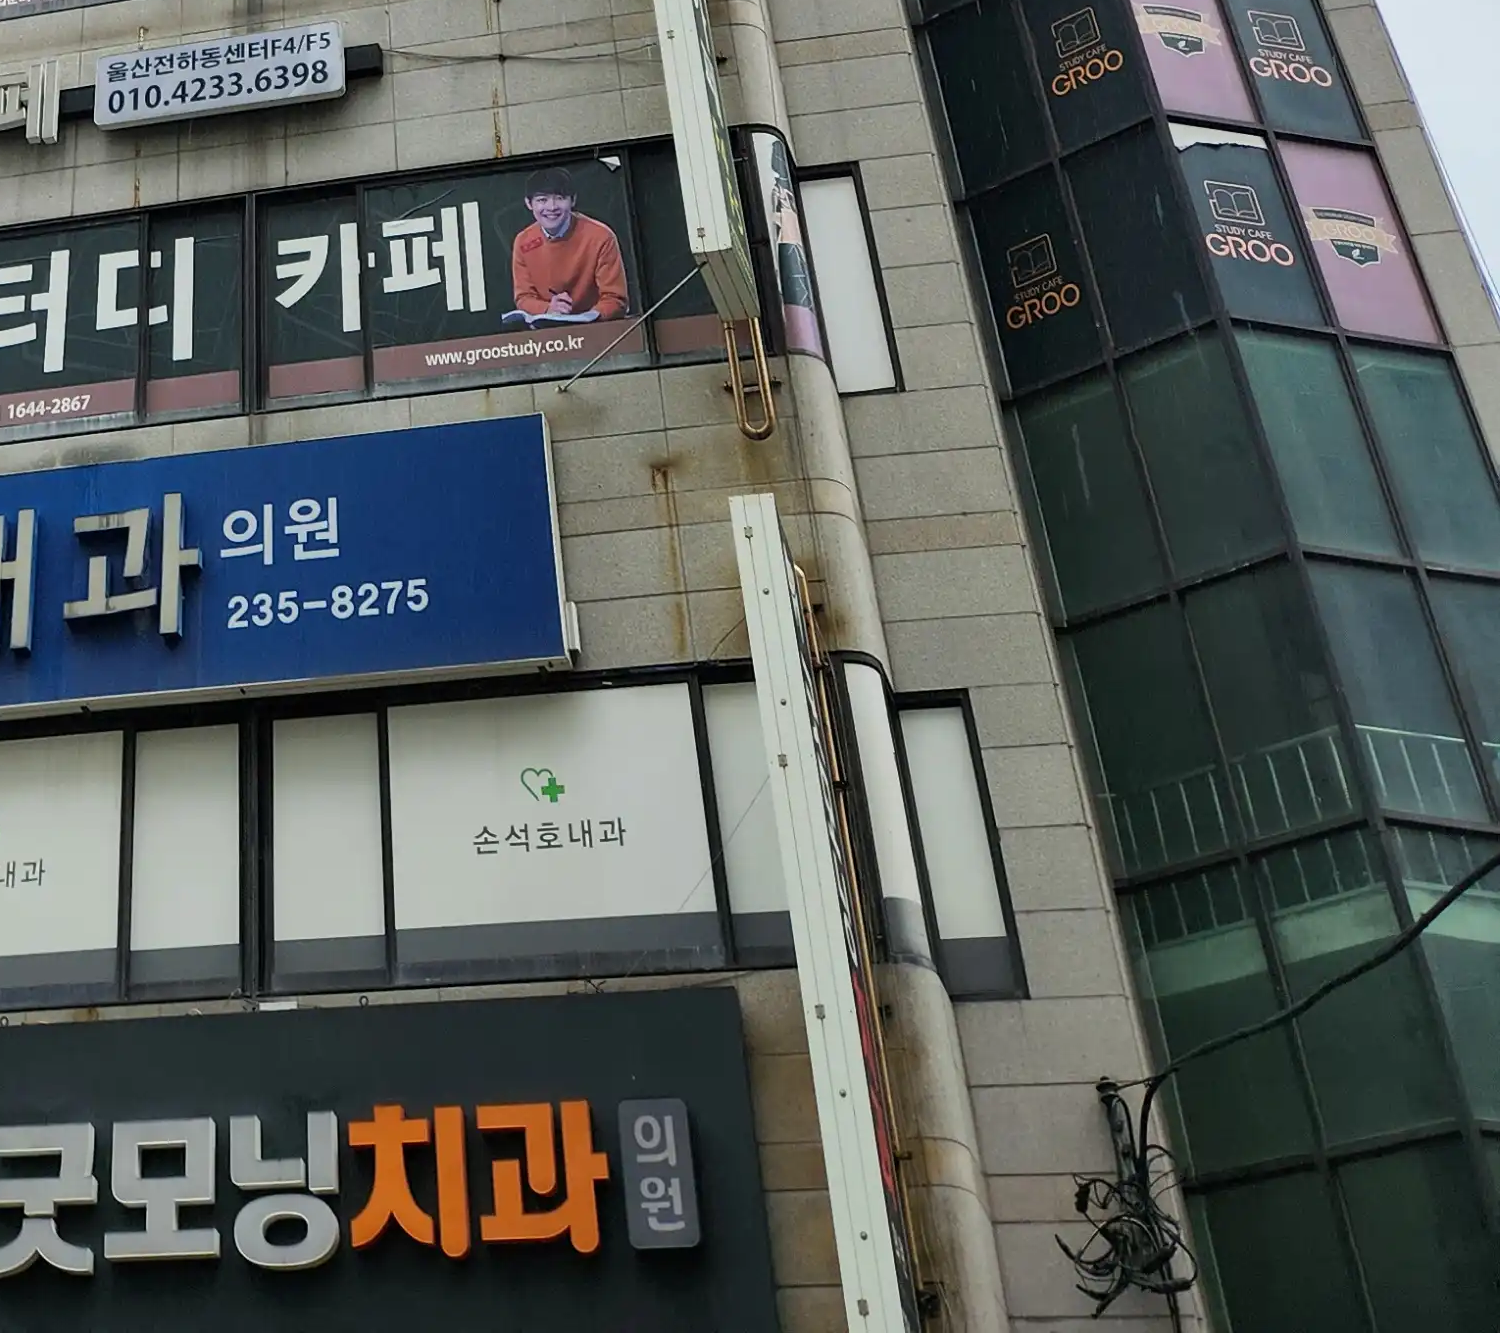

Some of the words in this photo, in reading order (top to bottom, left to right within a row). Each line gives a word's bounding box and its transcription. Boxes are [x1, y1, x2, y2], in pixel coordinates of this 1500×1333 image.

[1051, 49, 1124, 96] GROO
[1059, 54, 1085, 72] STUDY
[1085, 43, 1108, 59] CAFE
[1249, 56, 1333, 88] GROO
[1257, 48, 1288, 62] STUDY
[1288, 52, 1314, 65] CAFE
[107, 59, 329, 114] 010.4233.6398
[1214, 224, 1246, 237] STUDY
[1247, 228, 1275, 242] CAFE
[1322, 221, 1377, 241] GROO
[274, 201, 488, 332] 카페
[1205, 233, 1295, 267] GROO
[1006, 283, 1080, 329] GROO
[1014, 286, 1041, 303] STUDY
[1041, 275, 1065, 291] CAFE
[424, 332, 585, 368] www.groostudy.co.kr
[7, 393, 91, 420] 1644-2867
[219, 496, 340, 565] 의원
[226, 577, 429, 630] 235-8275
[472, 816, 627, 855] 손석호내과
